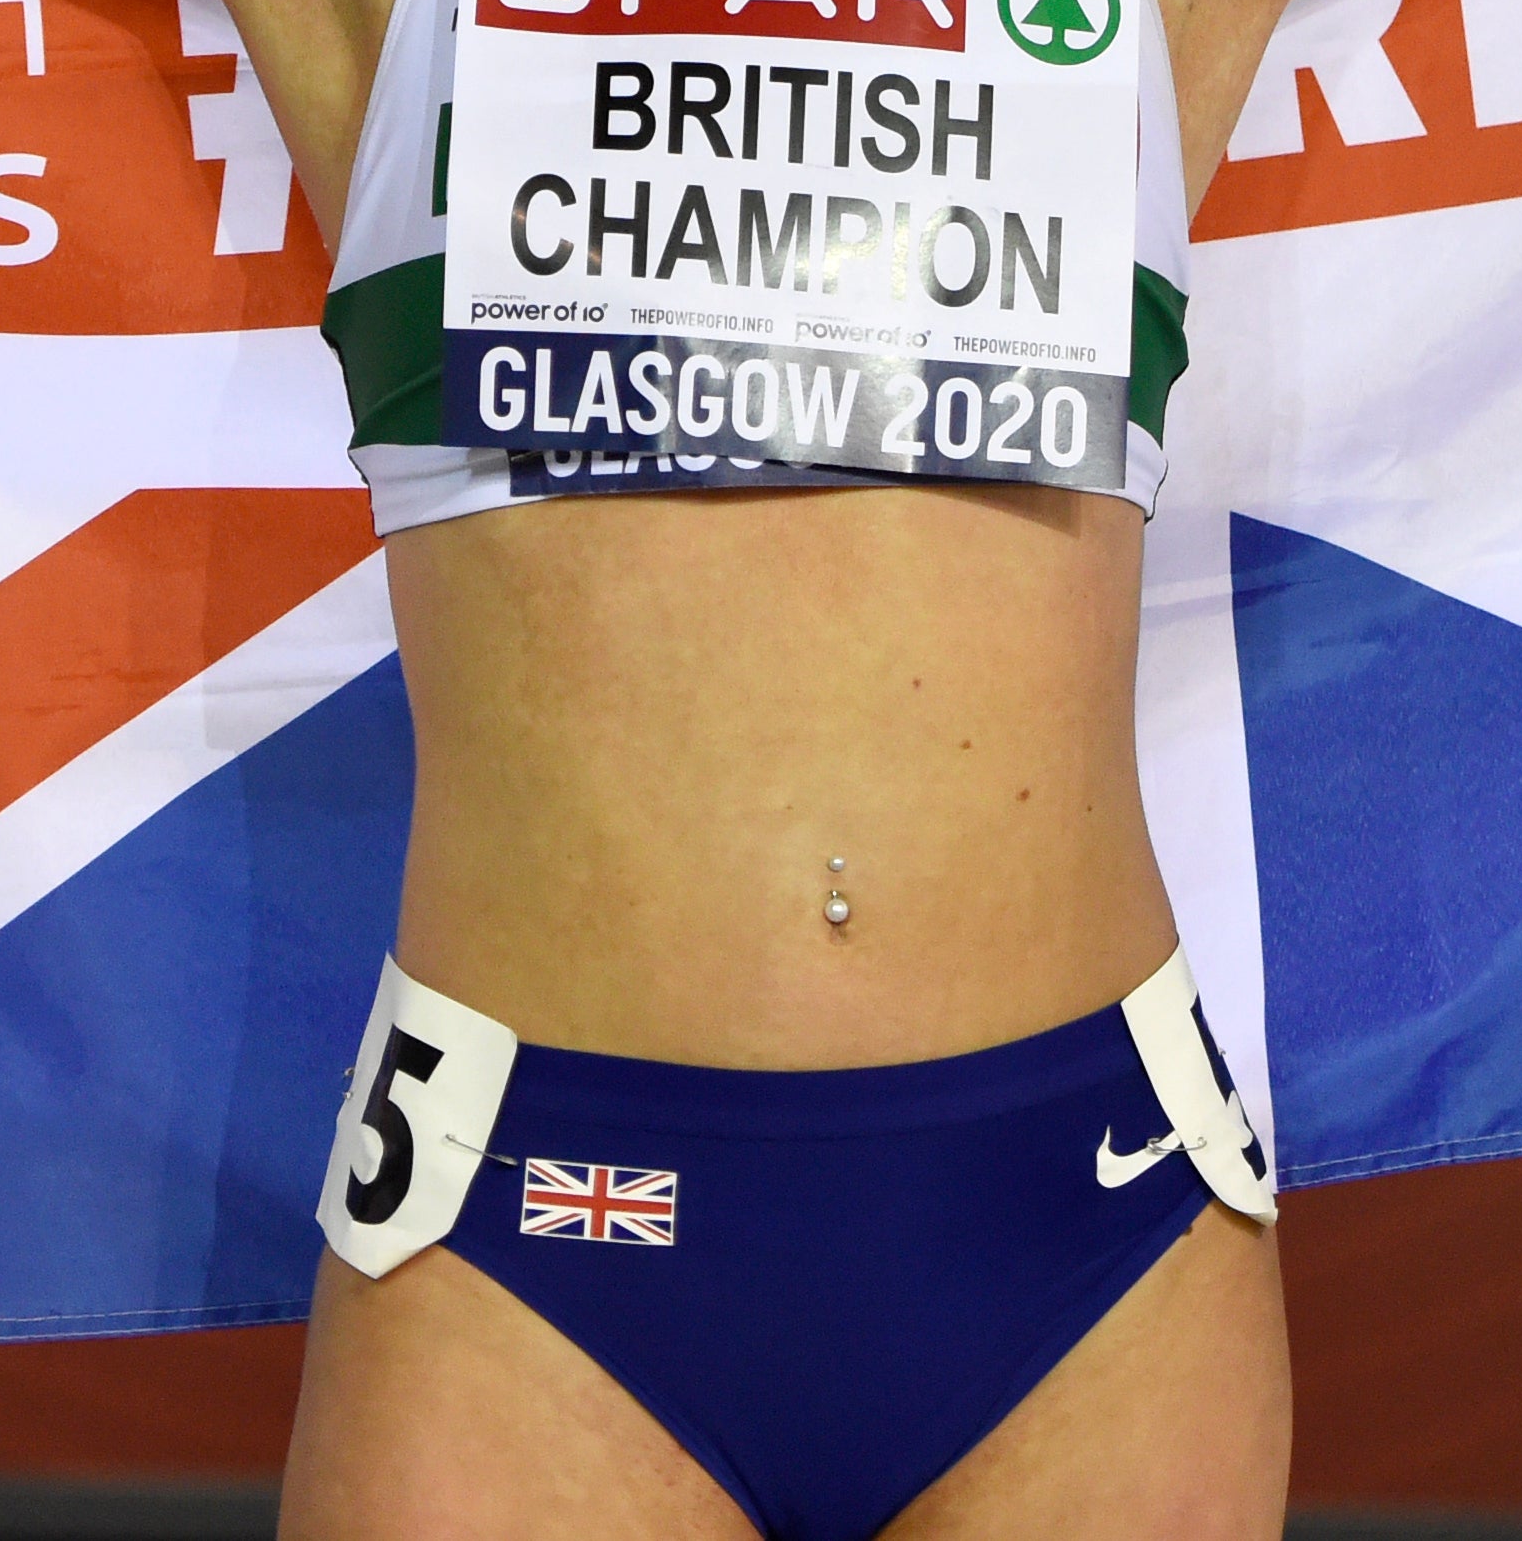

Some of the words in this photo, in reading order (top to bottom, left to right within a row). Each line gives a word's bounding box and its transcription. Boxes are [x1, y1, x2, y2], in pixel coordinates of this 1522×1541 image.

[592, 61, 995, 181] BRITISH
[510, 173, 1064, 315] CHAMPION
[470, 302, 552, 325] power
[553, 300, 578, 322] of
[630, 308, 774, 333] THEPOWEROF10.INFO
[794, 321, 875, 343] power
[953, 335, 1096, 362] THEPOWEROF10.INFO
[479, 348, 860, 449] GLASGOW
[880, 372, 1088, 468] 2020
[345, 1022, 446, 1226] 5
